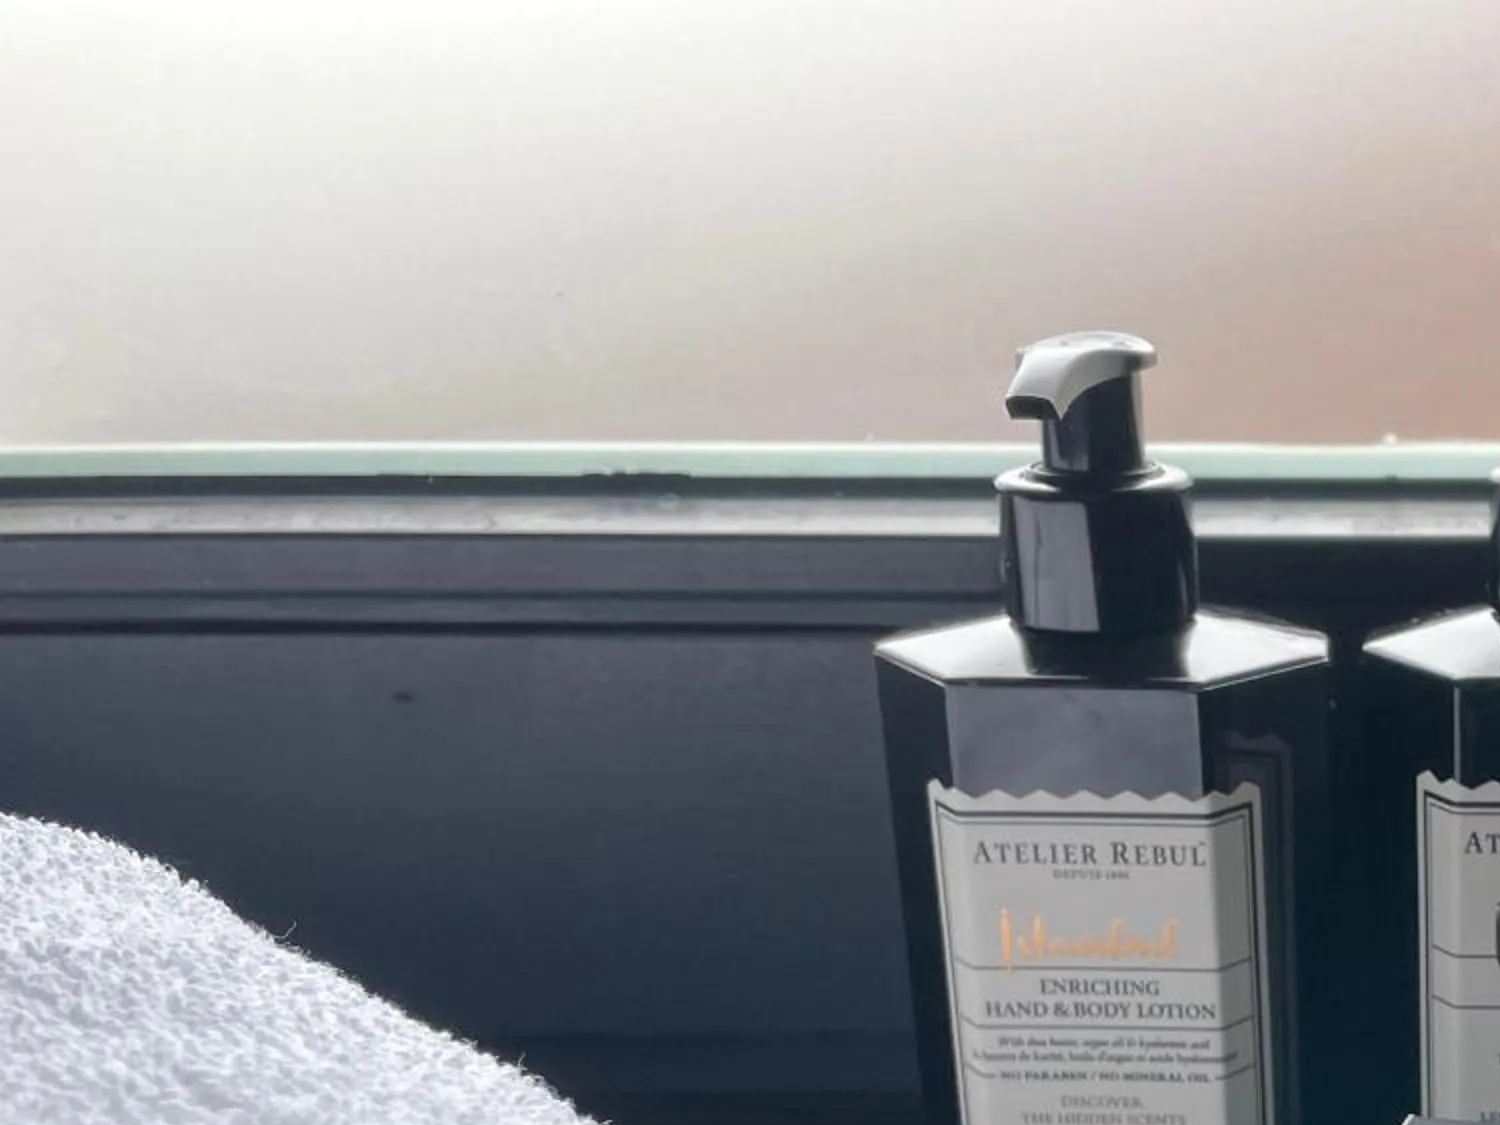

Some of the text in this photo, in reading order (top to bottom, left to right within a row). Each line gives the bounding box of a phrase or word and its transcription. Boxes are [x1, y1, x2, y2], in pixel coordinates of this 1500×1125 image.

[973, 841, 1206, 867] ATELIER REBUL
[1040, 978, 1160, 997] ENRICHING
[985, 1001, 1216, 1020] HAND & BODY LOTION
[1060, 1095, 1143, 1109] DISCOVER
[1021, 1111, 1053, 1125] THE
